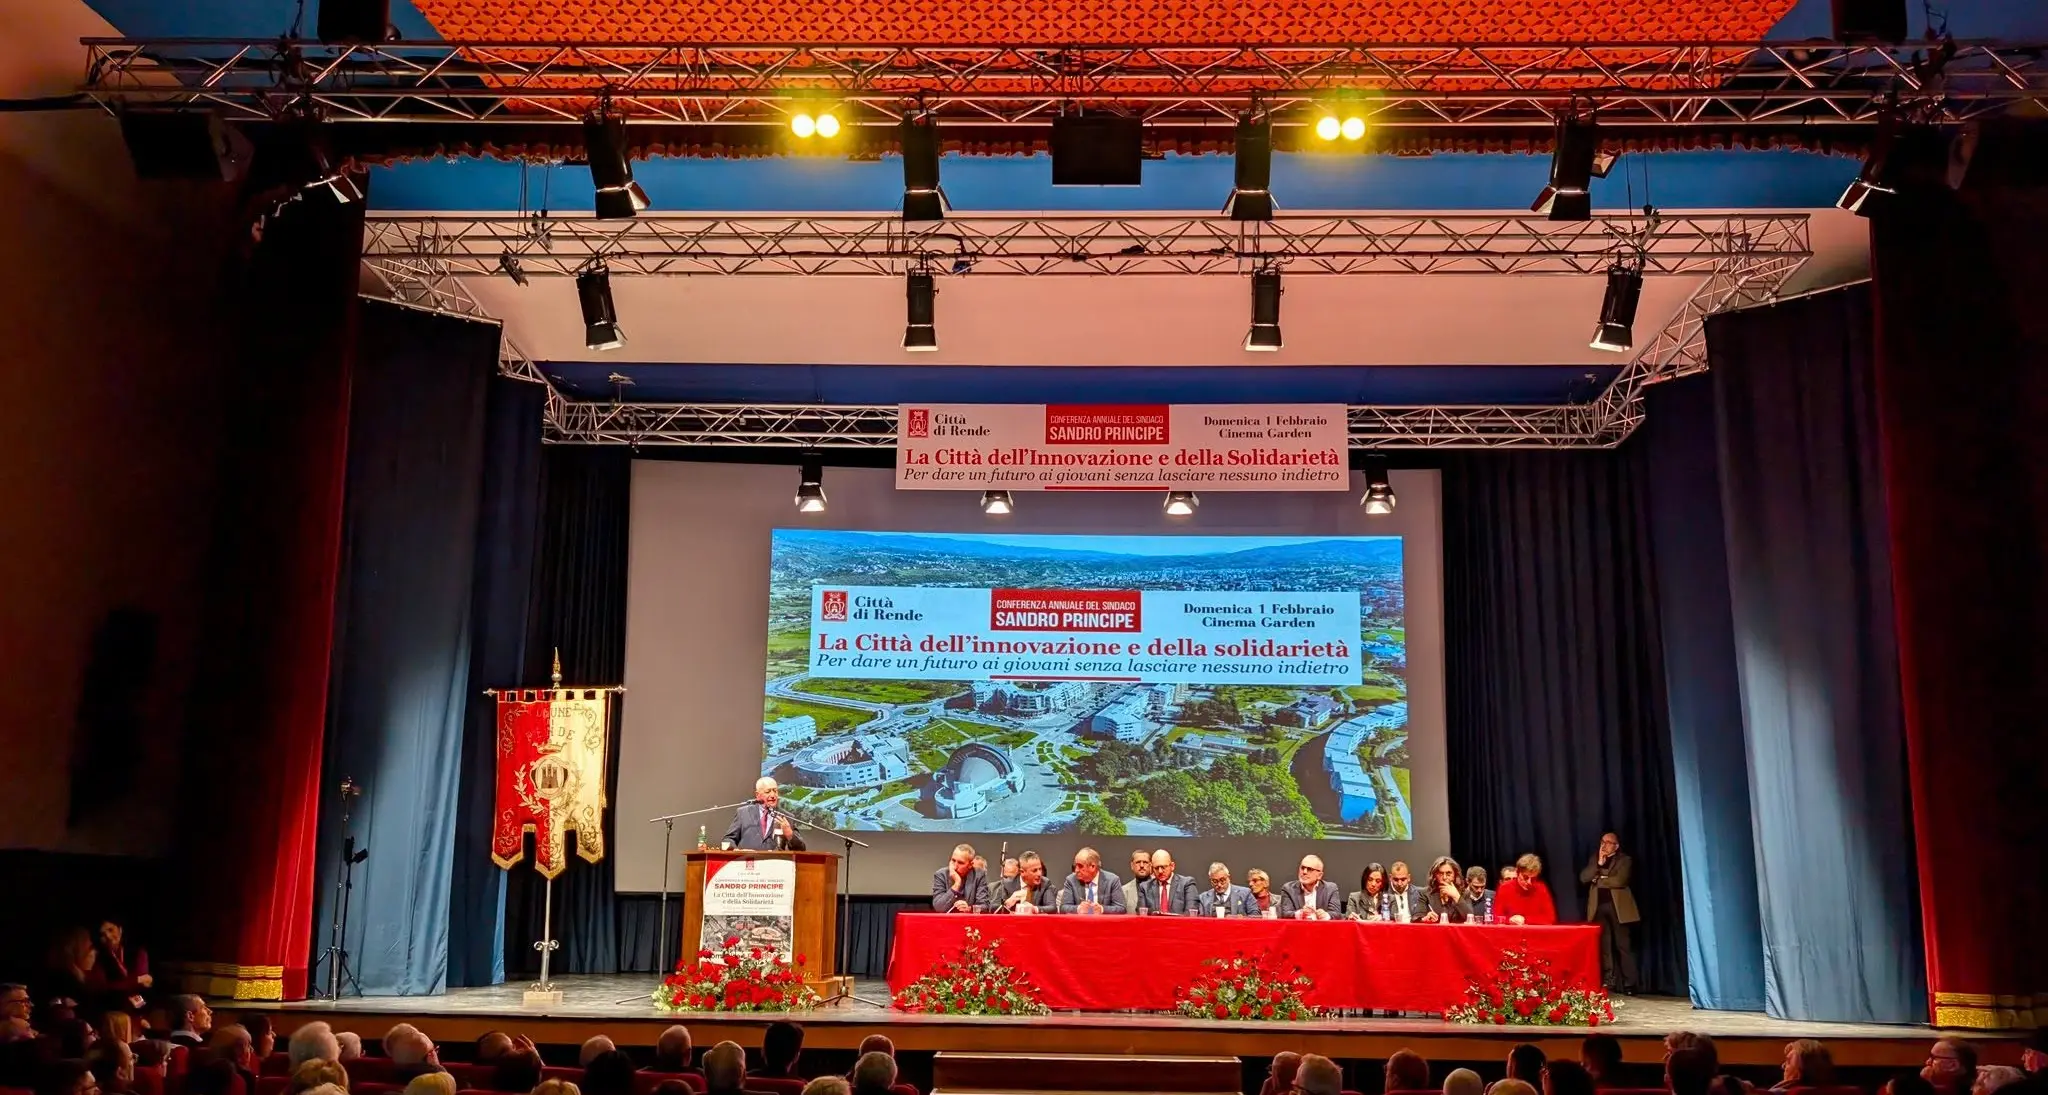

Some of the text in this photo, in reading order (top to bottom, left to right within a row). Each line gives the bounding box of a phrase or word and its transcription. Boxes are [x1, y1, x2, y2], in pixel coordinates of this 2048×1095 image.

[934, 413, 967, 425] Città
[1050, 415, 1164, 424] CONFERENZA ANNUALE DEL SINDACO
[1204, 416, 1328, 426] Domenica 1 Febbraio
[933, 425, 991, 436] di Rende
[1050, 426, 1164, 441] SANDRO PRINCIPE
[1218, 428, 1312, 438] Cinema Garden
[905, 449, 930, 466] La
[935, 449, 982, 466] Città
[1158, 453, 1170, 466] e
[1174, 449, 1224, 466] della
[1227, 449, 1340, 466] Solidarietà
[904, 468, 1340, 484] Per dare un futuro ai giovani senza lasciare nessuno indietro
[854, 596, 894, 608] Città
[996, 600, 1136, 611] CONFERENZA ANNUALE DEL SINDACO
[853, 608, 924, 622] di Rende
[1184, 603, 1334, 615] Domenica 1 Febbraio
[996, 612, 1134, 629] SANDRO PRINCIPE
[1202, 616, 1316, 628] Cinema Garden
[818, 634, 848, 651] La
[855, 634, 912, 652] Città
[1127, 642, 1141, 656] e
[1146, 638, 1208, 656] della
[1214, 639, 1350, 658] solidarietà
[817, 654, 1349, 675] Per dare un futuro ai giovani senza lasciare nessuno indietro
